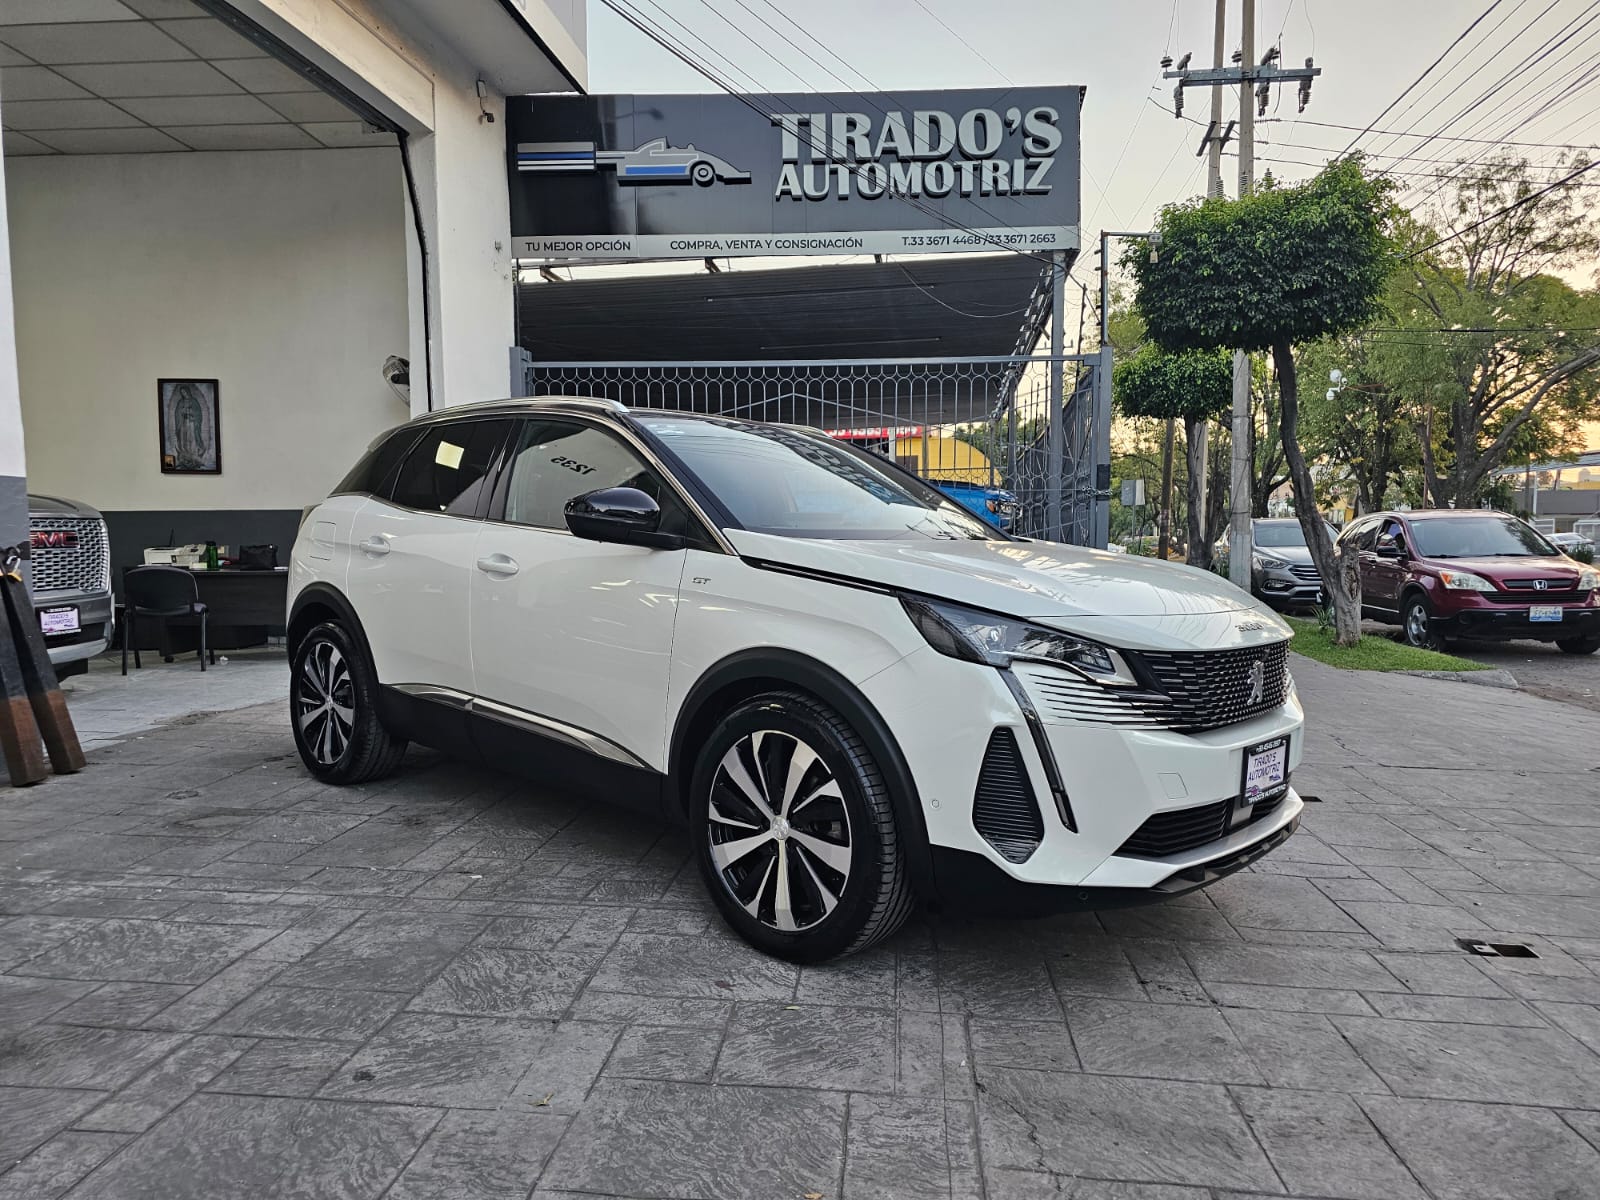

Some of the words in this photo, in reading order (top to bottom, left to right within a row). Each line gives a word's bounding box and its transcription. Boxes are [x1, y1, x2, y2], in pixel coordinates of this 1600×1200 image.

[771, 106, 1063, 163] TIRADO'S
[775, 156, 1056, 200] AUTOMOTRIZ
[525, 241, 541, 251] TU
[543, 241, 583, 251] MEJOR
[585, 239, 631, 251] OPCIÓN
[670, 240, 723, 251] COMPRA,
[725, 239, 763, 249] VENTA
[765, 239, 773, 249] Y
[774, 236, 863, 249] CONSIGNACIÓN
[902, 236, 924, 246] T.33
[926, 235, 950, 246] 3671
[953, 234, 981, 245] 4468
[1004, 234, 1027, 244] 3671
[1030, 233, 1056, 244] 2663
[692, 576, 712, 585] GT
